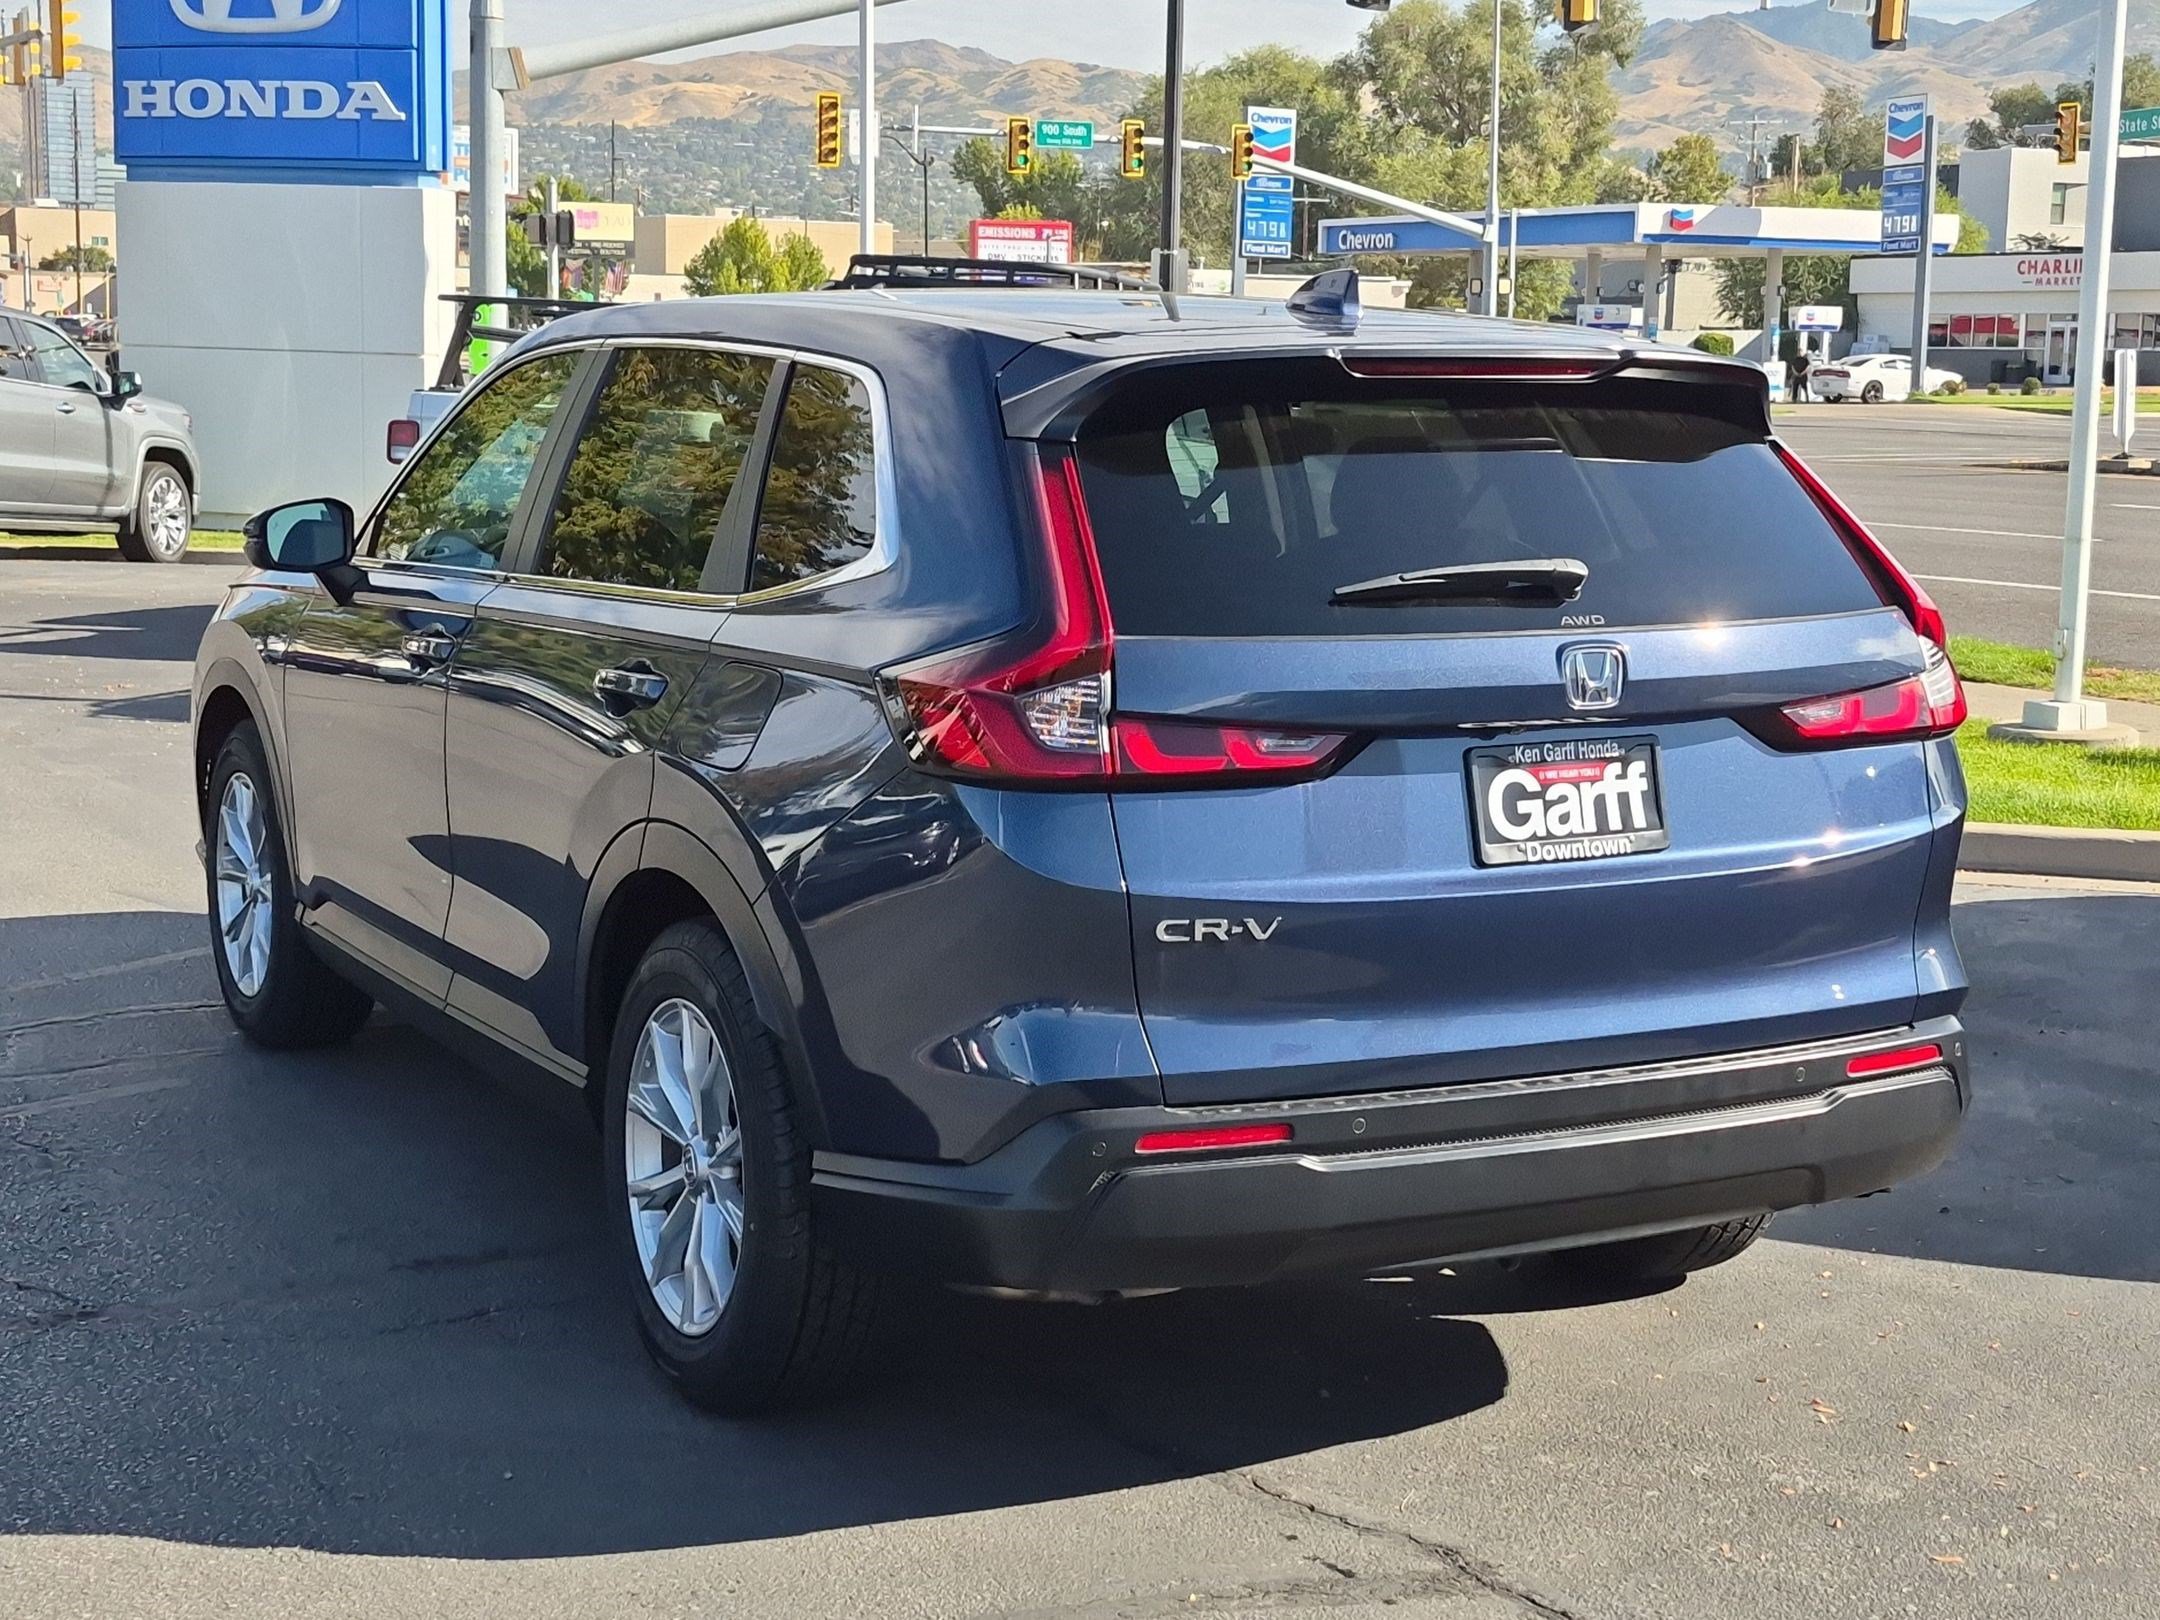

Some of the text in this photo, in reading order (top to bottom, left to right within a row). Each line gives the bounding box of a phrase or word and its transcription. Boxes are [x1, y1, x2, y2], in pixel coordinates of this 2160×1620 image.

[122, 78, 407, 121] HONDA
[1888, 102, 1924, 113] Chevron
[1251, 112, 1292, 124] Chevron
[2119, 117, 2148, 134] State
[1041, 123, 1088, 136] 900 South
[978, 226, 1037, 240] EMISSIONS
[1338, 229, 1394, 250] Chevron
[1246, 244, 1287, 255] Food Mart
[1560, 614, 1606, 627] AWD
[1514, 740, 1619, 763] Ken Garff Honda
[1488, 760, 1648, 841] Garff
[1526, 838, 1631, 862] Downtown
[1155, 916, 1283, 942] CR-V
